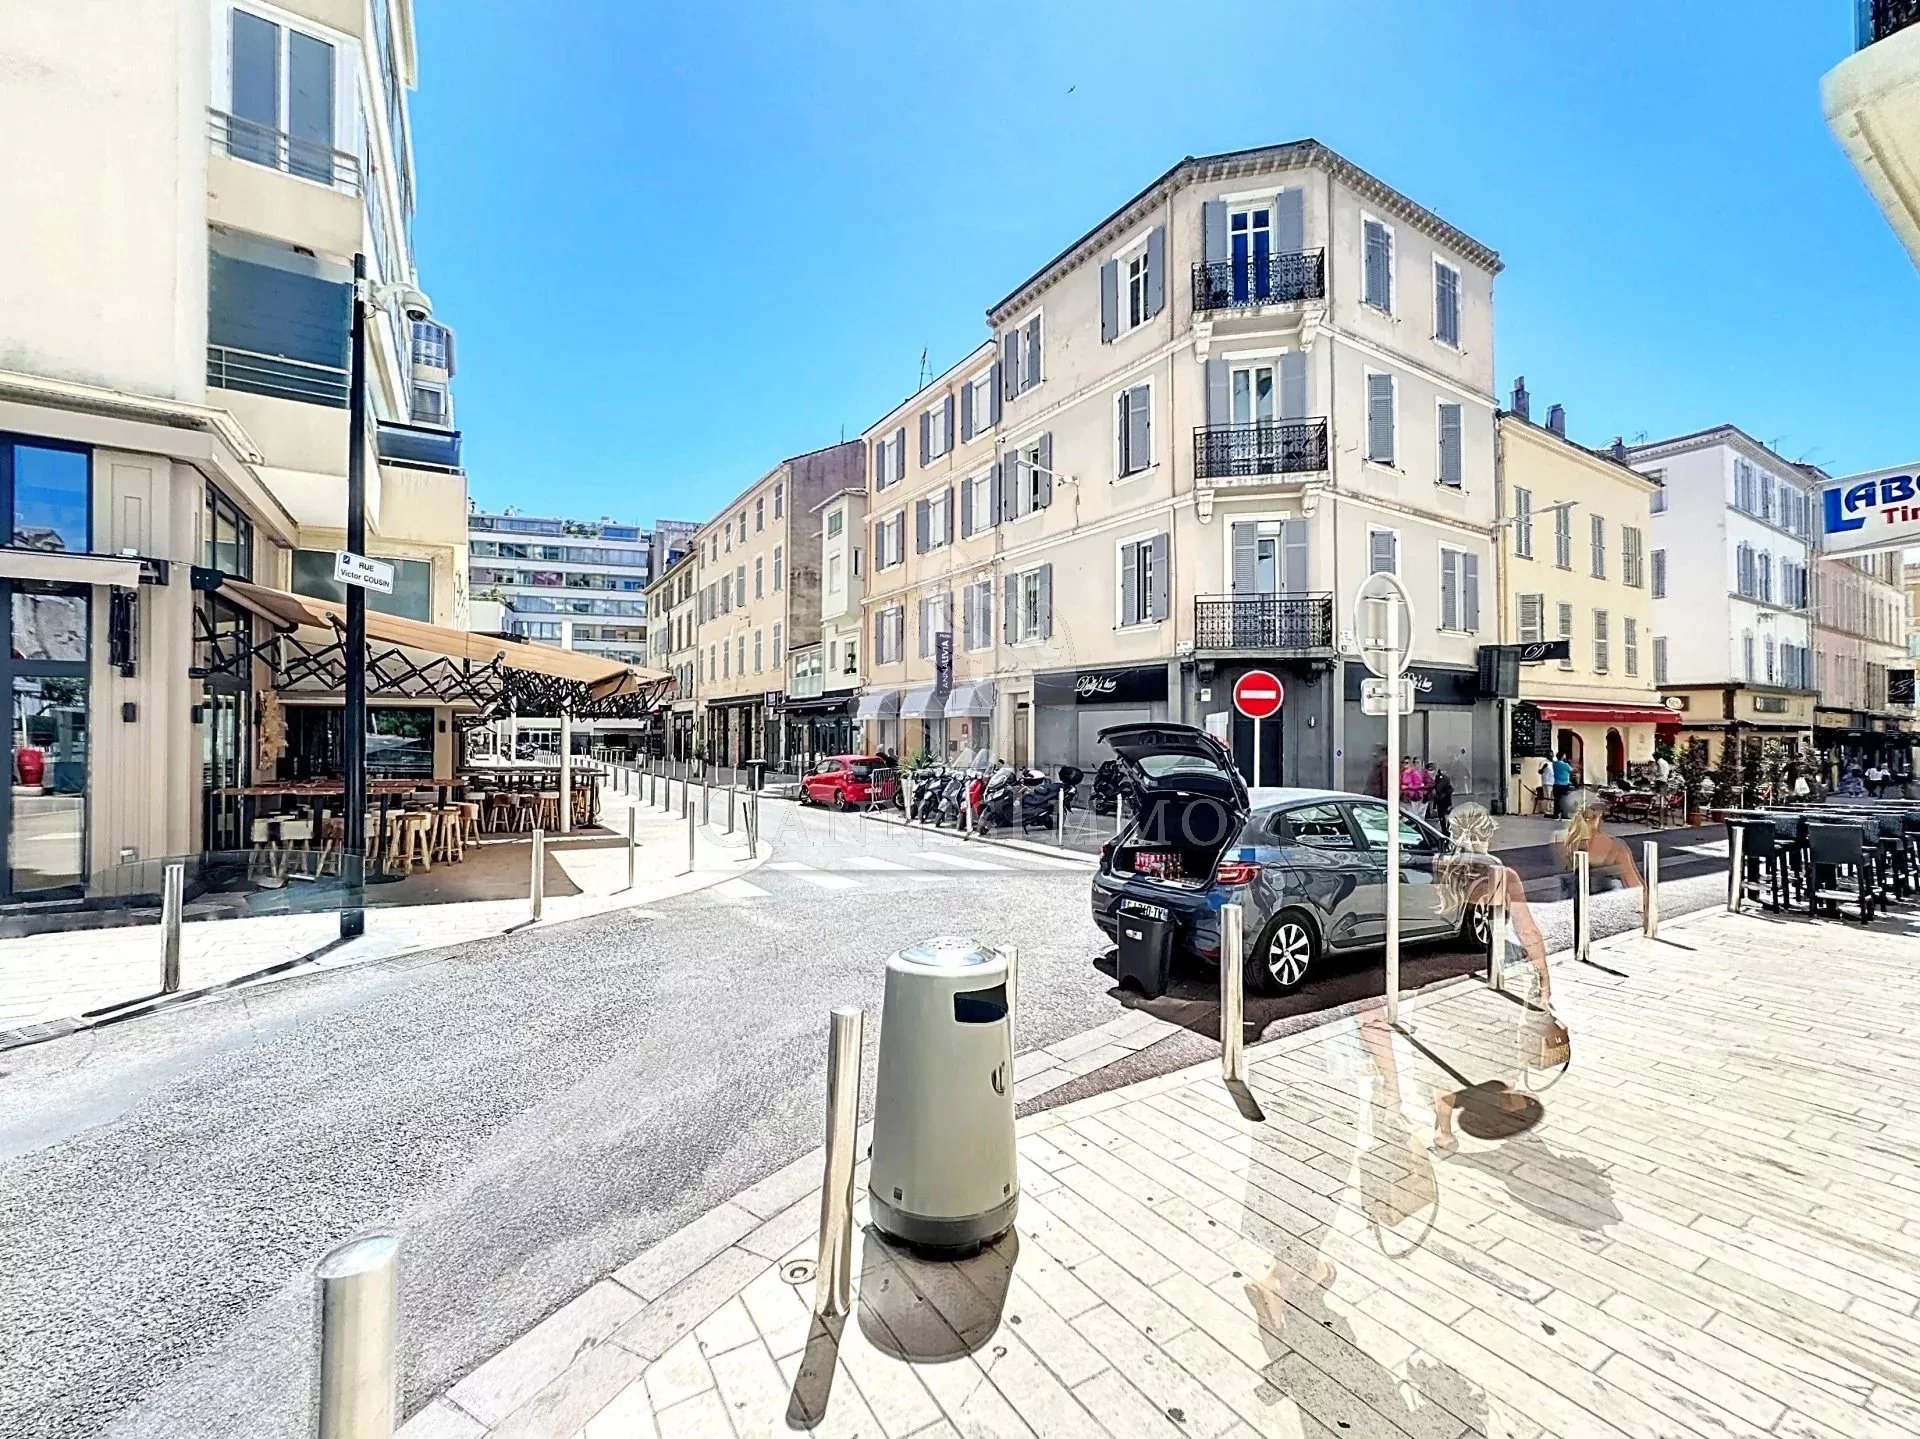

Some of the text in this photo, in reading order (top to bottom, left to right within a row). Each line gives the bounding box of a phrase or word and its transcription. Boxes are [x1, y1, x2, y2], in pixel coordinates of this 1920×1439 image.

[1822, 475, 1920, 534] LAB
[358, 562, 374, 572] RUE
[340, 569, 390, 588] Victor COUSIN
